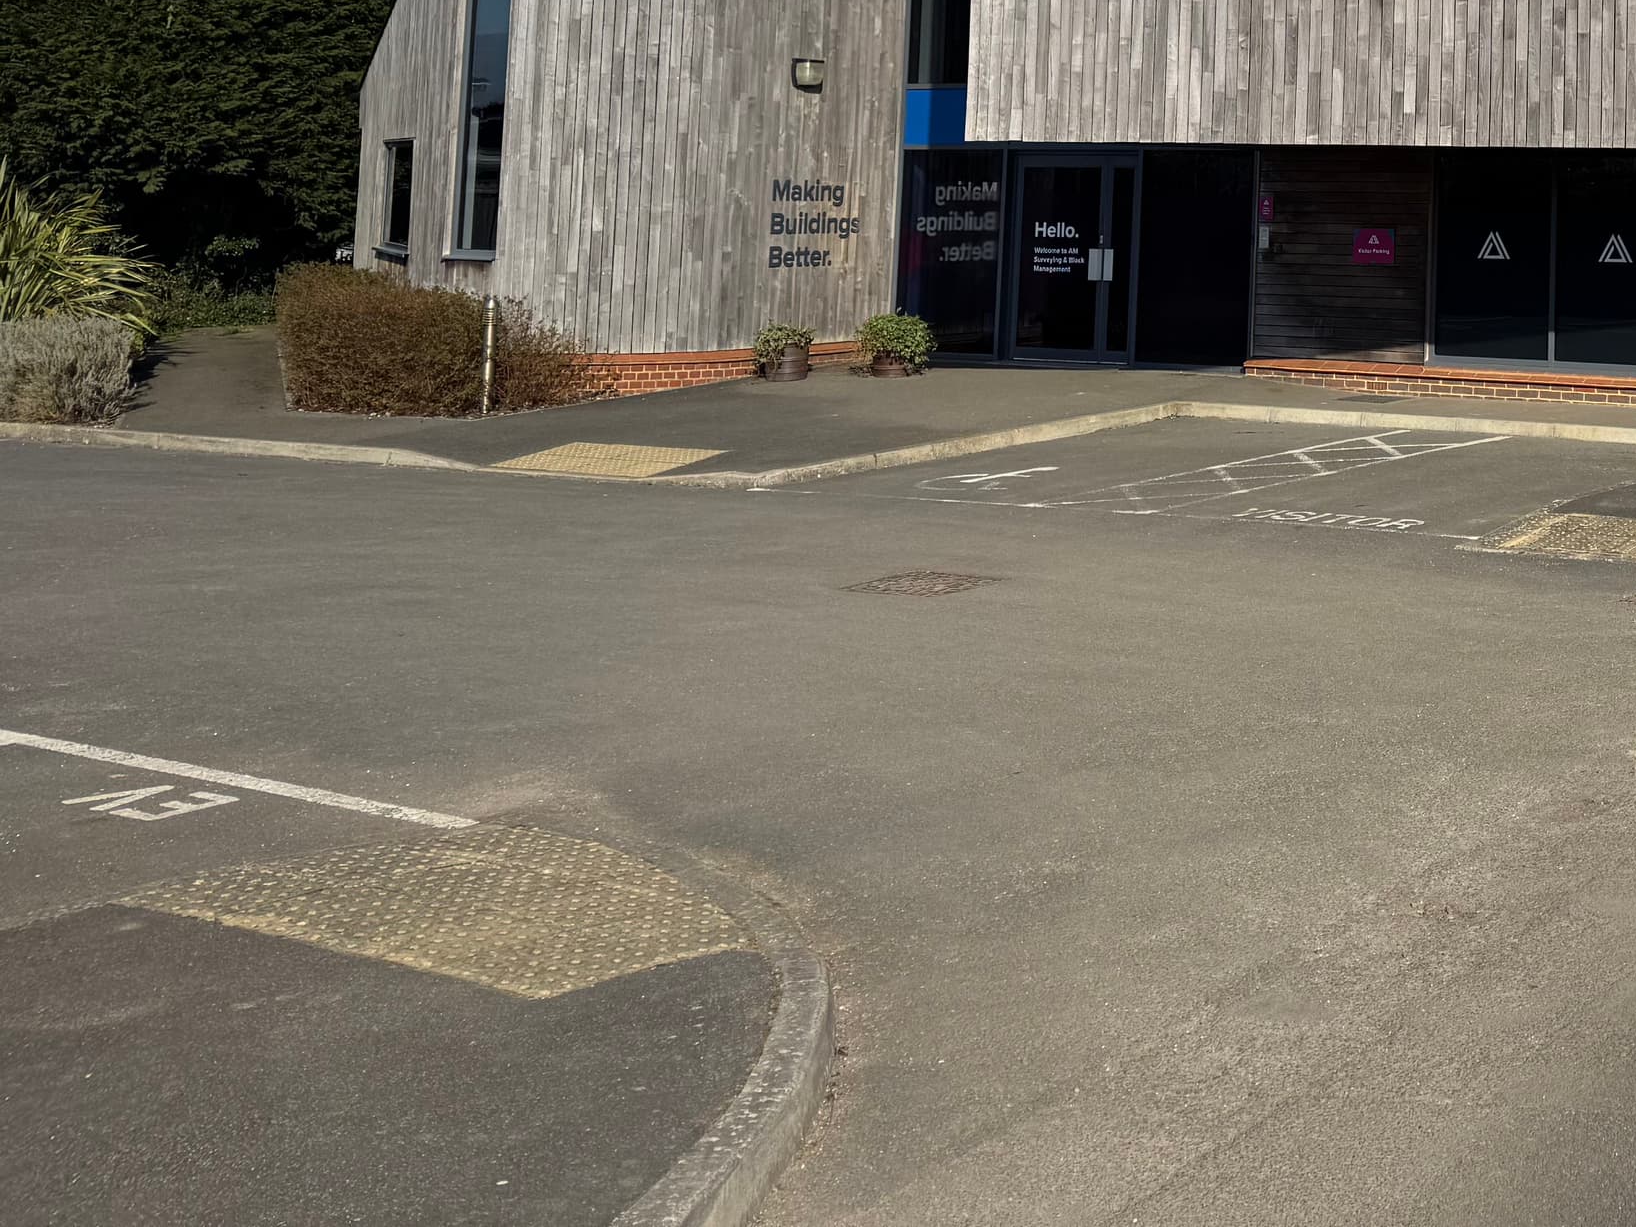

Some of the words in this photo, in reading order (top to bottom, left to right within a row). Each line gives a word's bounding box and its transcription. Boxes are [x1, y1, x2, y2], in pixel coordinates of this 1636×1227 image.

[772, 179, 844, 207] Making
[770, 212, 860, 239] Buildings
[1034, 222, 1079, 238] Hello.
[768, 246, 832, 268] Better.
[1033, 265, 1071, 273] Management
[1232, 508, 1425, 529] VISITOR
[61, 785, 241, 821] EV
